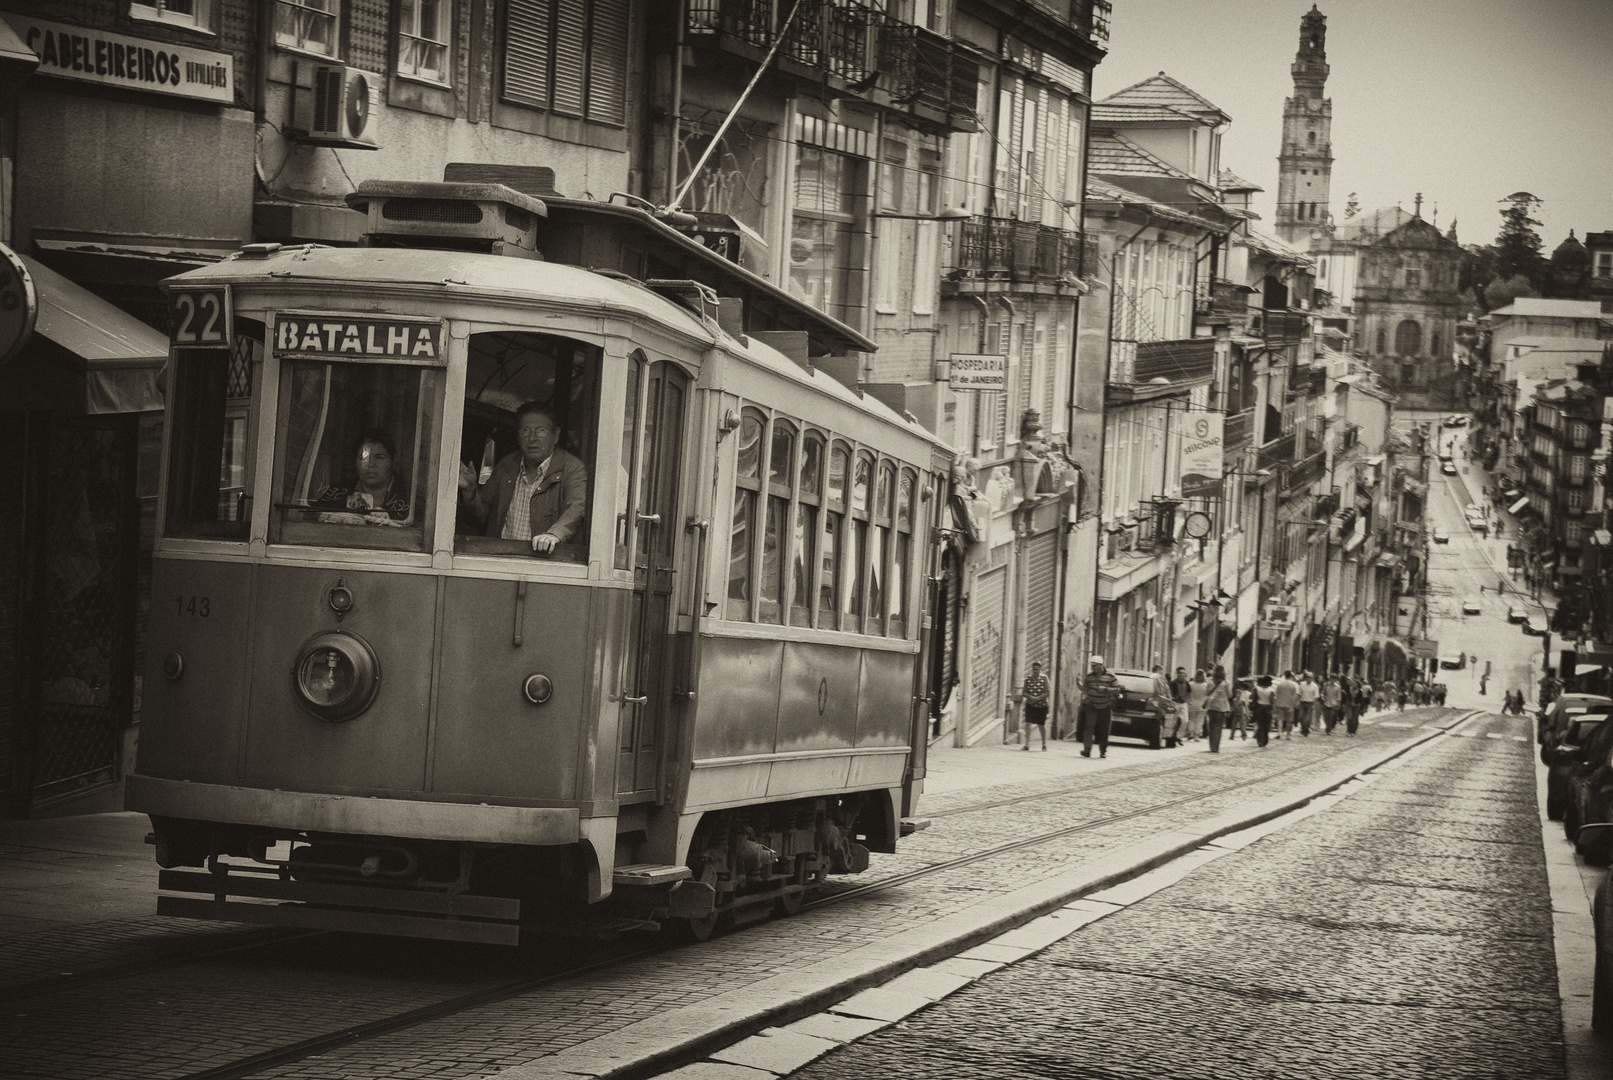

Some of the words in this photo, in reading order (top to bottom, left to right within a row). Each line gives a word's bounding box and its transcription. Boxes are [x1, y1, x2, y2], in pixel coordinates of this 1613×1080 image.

[26, 26, 180, 86] CABELEIREIROS
[175, 292, 222, 342] 22
[277, 321, 435, 357] BATALHA
[950, 359, 1004, 371] HOSPEDARIA
[970, 375, 1004, 384] JANEIRO
[176, 595, 211, 618] 143
